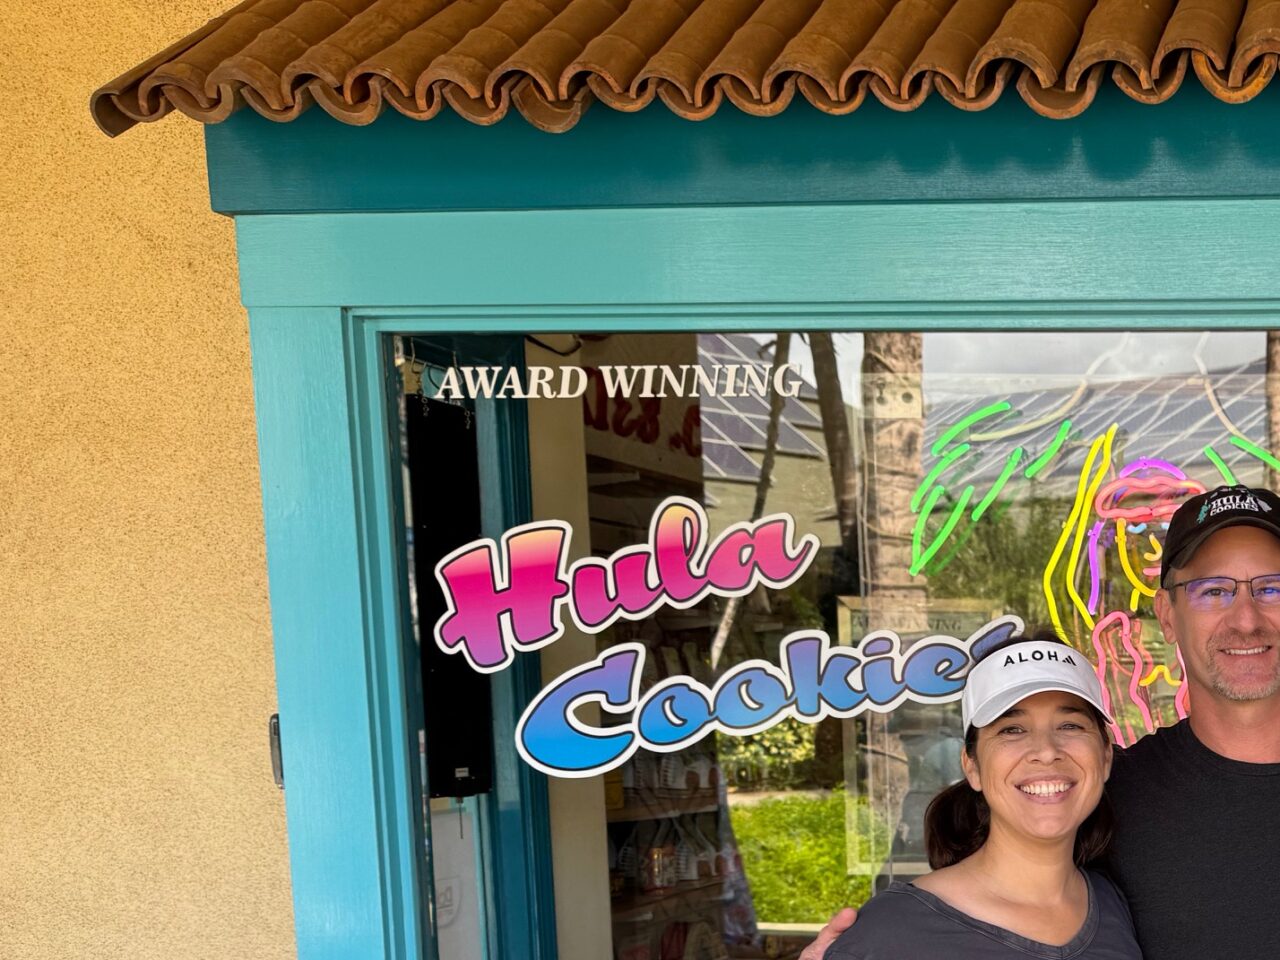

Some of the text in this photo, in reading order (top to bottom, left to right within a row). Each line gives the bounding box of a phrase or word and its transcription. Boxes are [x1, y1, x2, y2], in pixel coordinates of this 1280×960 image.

[434, 364, 803, 398] AWARD WINNING
[1210, 503, 1259, 516] COOKIES
[1211, 495, 1256, 509] HULA
[434, 496, 820, 674] Hula
